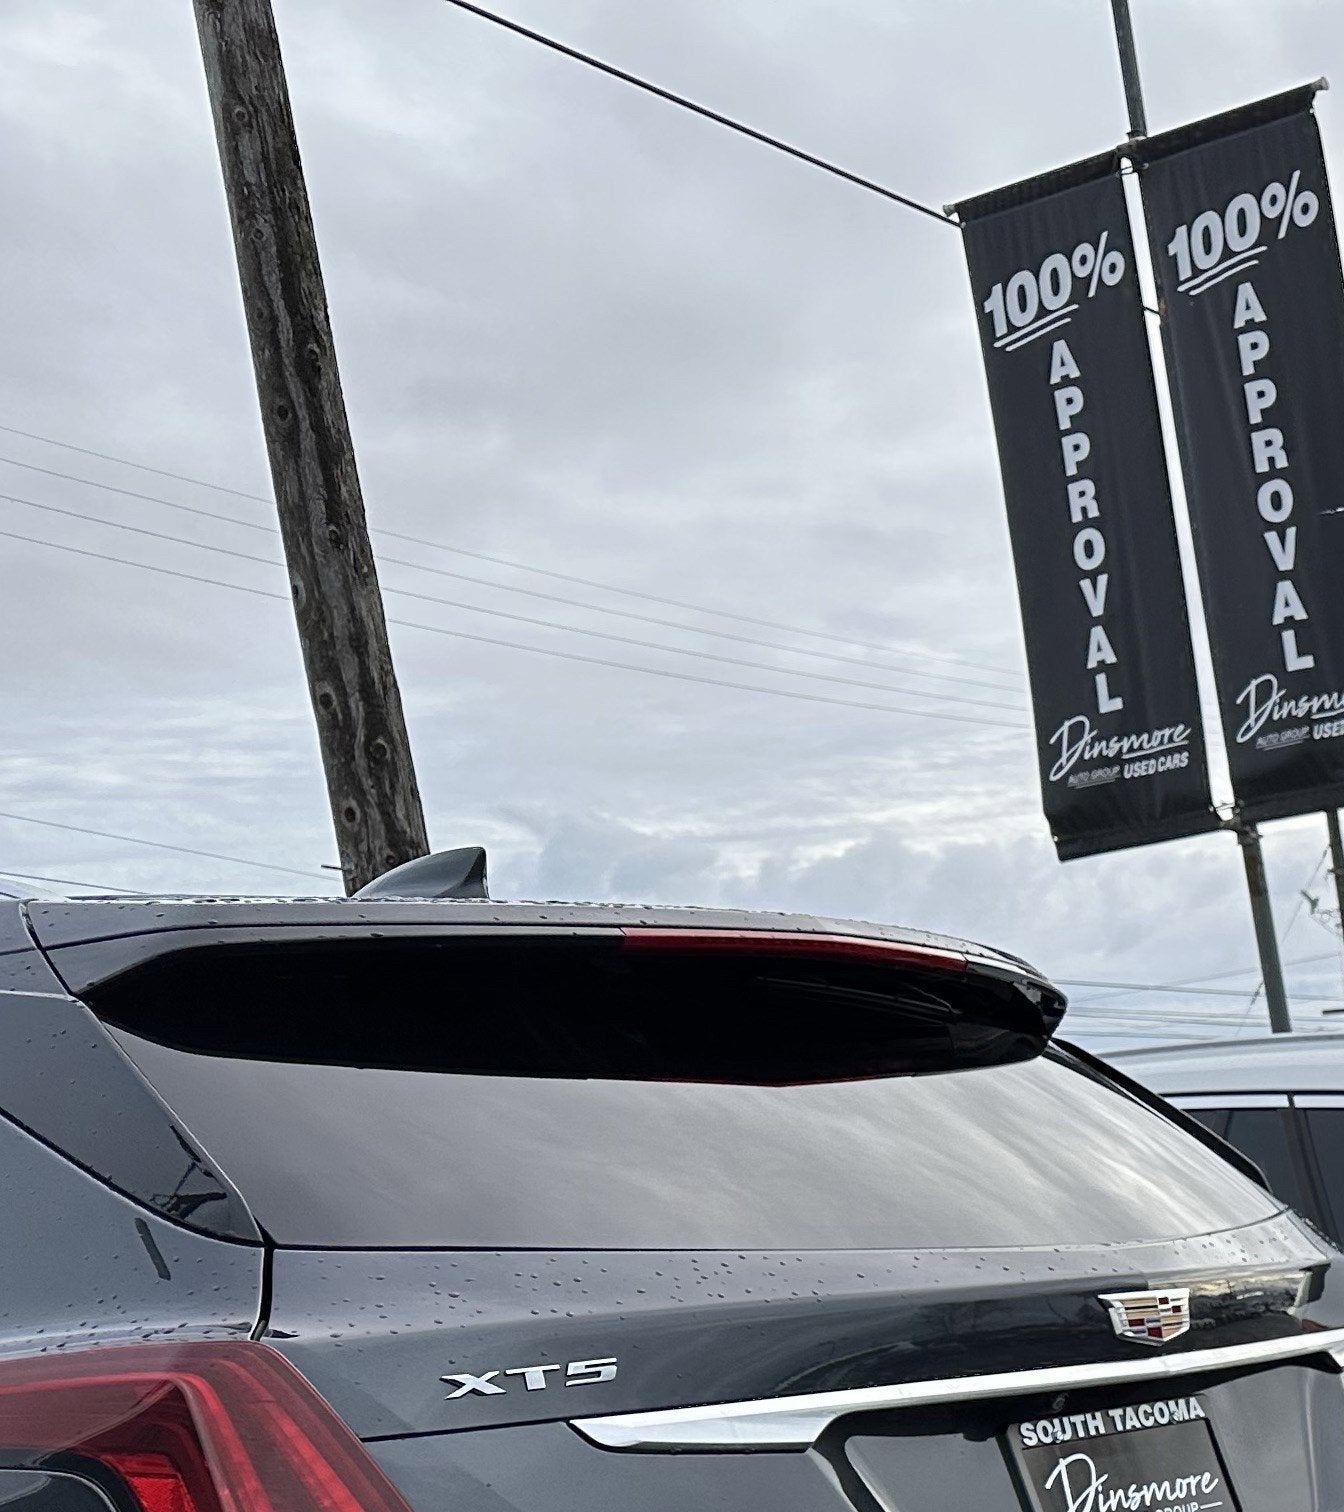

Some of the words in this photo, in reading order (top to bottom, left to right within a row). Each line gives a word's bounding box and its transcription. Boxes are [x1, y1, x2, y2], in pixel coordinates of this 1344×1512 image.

[1167, 171, 1319, 280] 100%
[984, 231, 1125, 338] 100%
[1233, 282, 1315, 672] APPROVAL
[1049, 339, 1123, 715] APPROVAL
[1049, 714, 1192, 783] Dinsmore
[1123, 758, 1156, 780] USED
[1156, 751, 1190, 773] CARS
[439, 1357, 617, 1400] XT5
[1019, 1412, 1106, 1447] SOUTH
[1108, 1396, 1206, 1432] TACOMA
